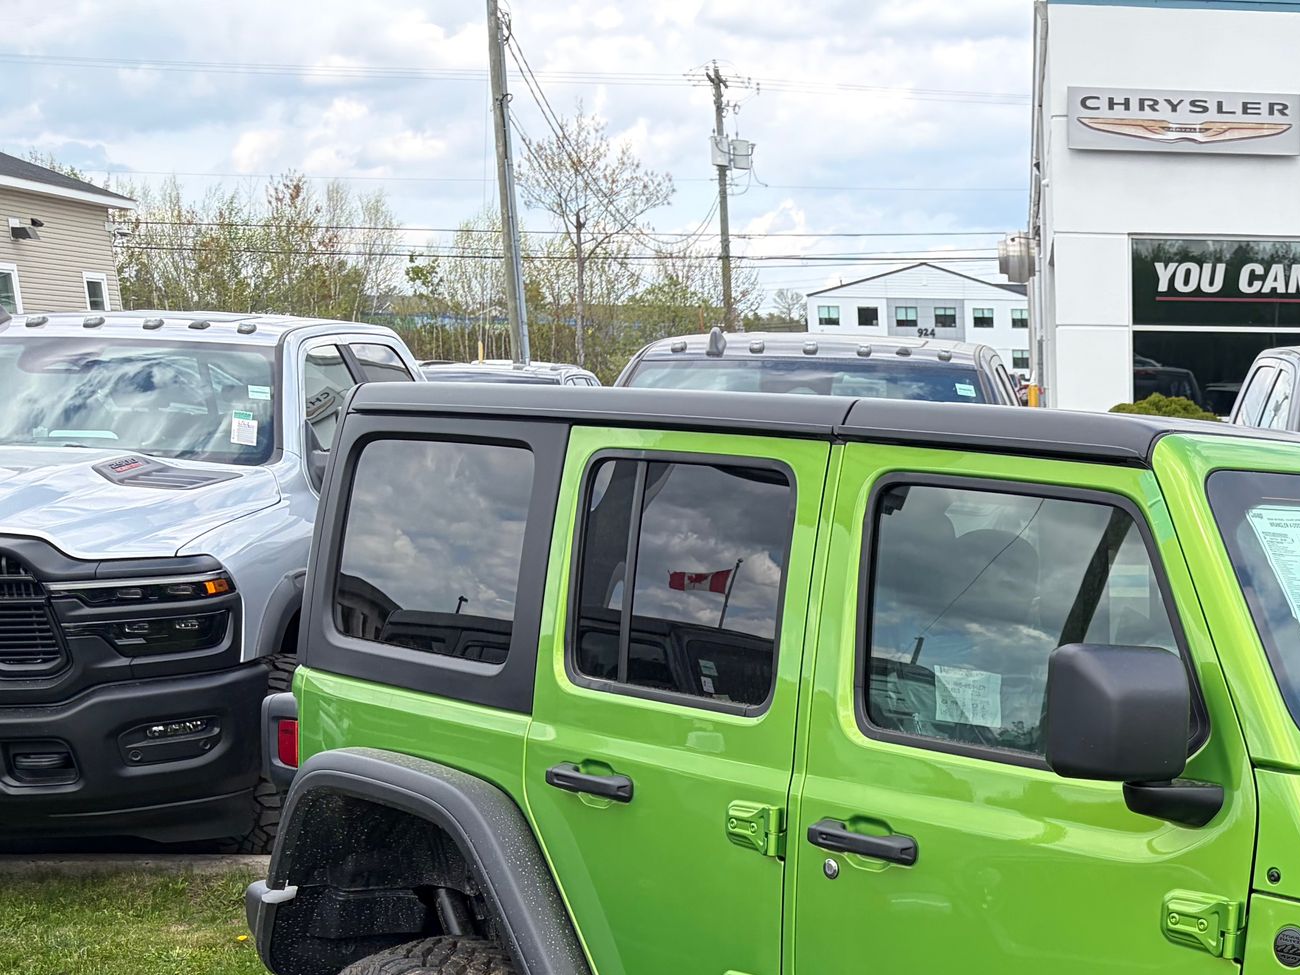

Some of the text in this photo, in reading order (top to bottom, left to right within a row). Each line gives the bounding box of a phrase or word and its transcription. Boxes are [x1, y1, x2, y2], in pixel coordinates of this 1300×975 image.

[1080, 95, 1290, 117] CHRYSLER
[1154, 262, 1226, 294] YOU
[917, 327, 936, 338] 924
